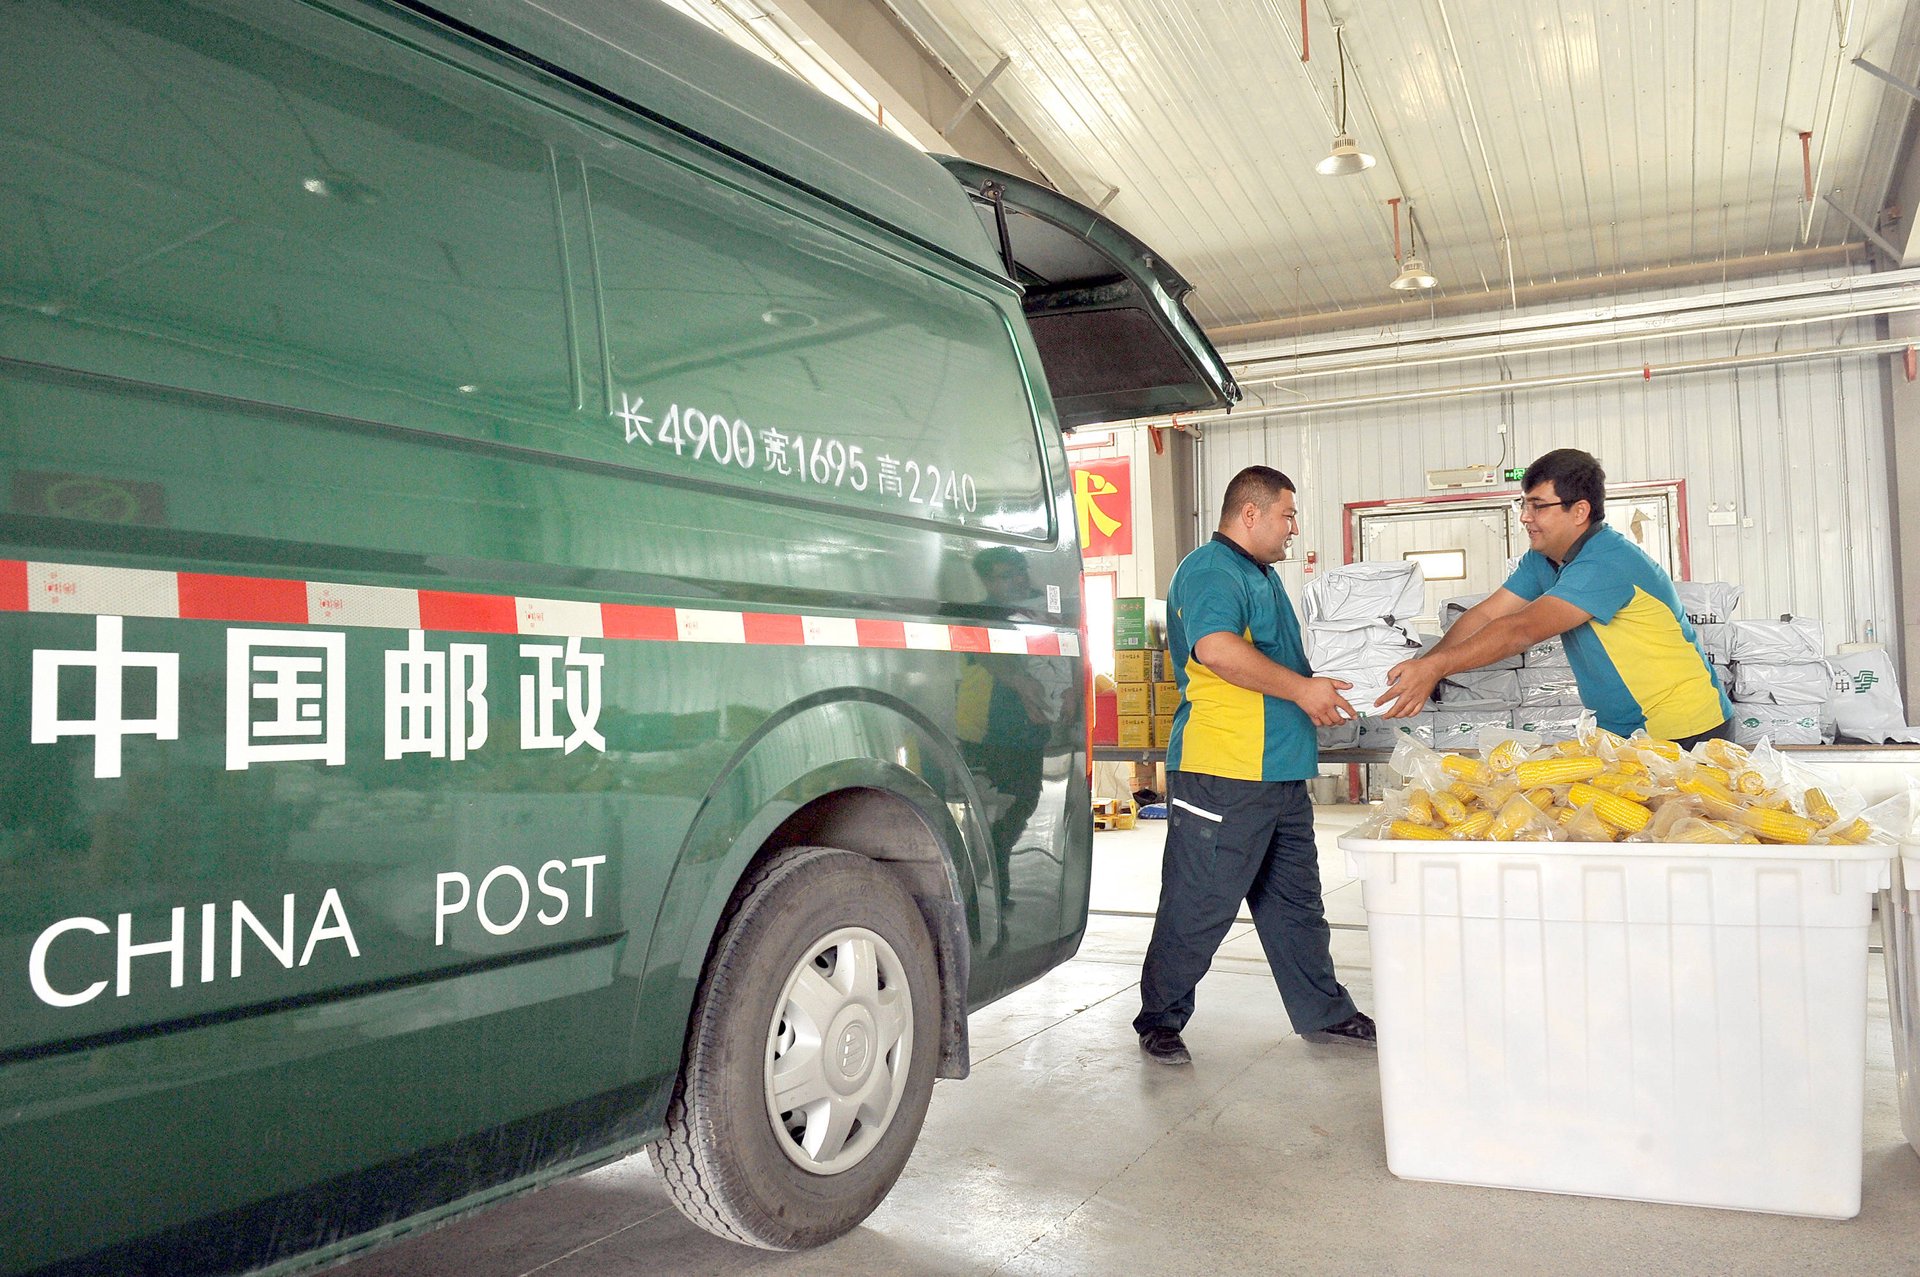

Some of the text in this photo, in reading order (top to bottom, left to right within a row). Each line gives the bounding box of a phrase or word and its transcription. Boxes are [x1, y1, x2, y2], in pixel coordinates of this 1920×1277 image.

[30, 614, 606, 779] 中国邮政
[28, 854, 607, 1008] CHINA POST
